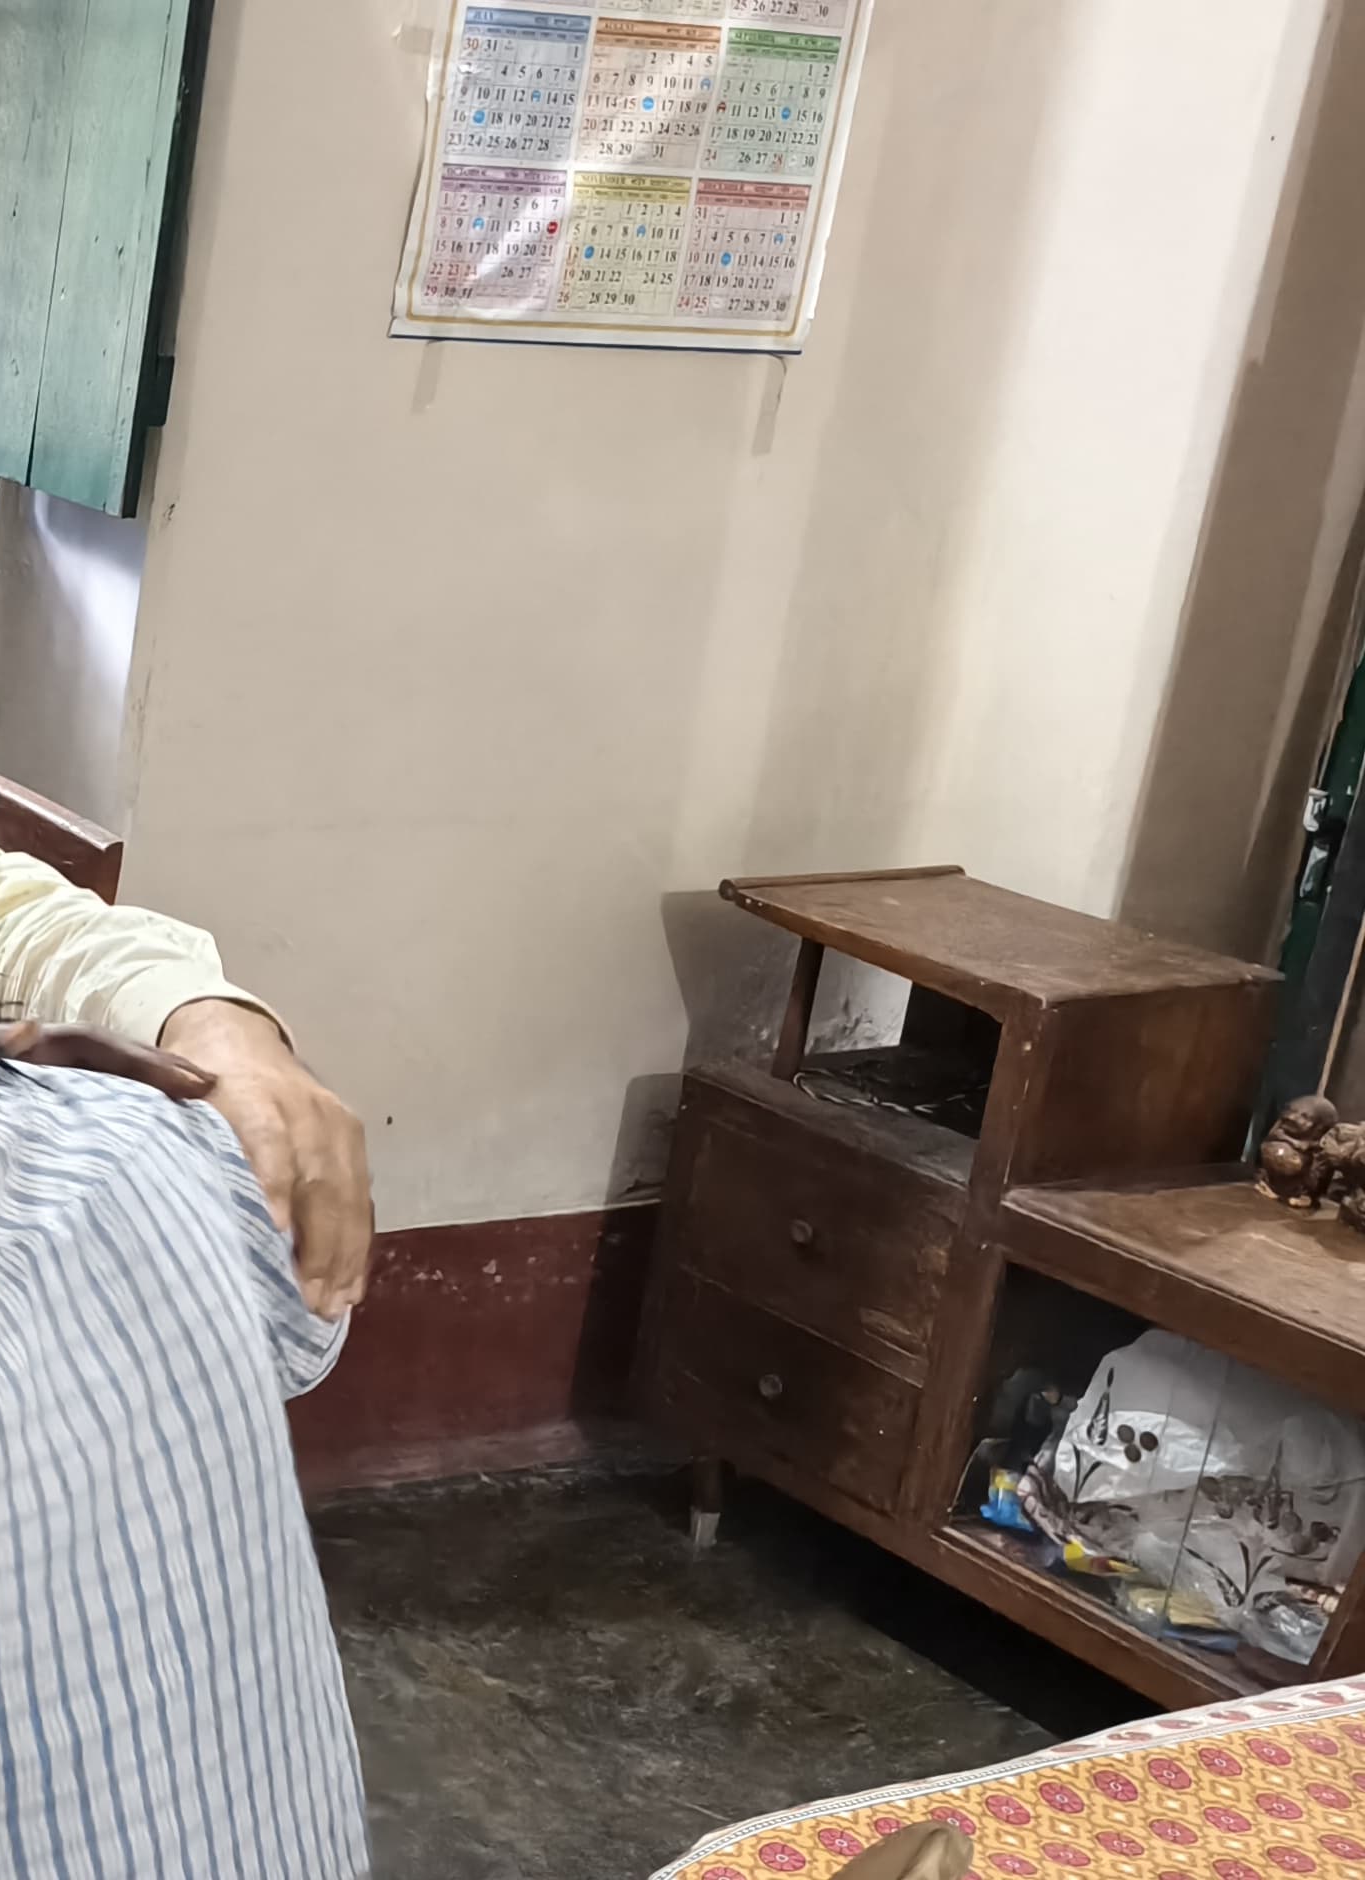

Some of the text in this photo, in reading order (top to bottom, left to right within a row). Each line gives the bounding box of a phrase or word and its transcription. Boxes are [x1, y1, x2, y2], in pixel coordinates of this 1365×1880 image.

[753, 1, 765, 12] 26
[787, 3, 798, 14] 28
[465, 38, 578, 58] 30 31 1
[651, 52, 657, 63] 2
[668, 53, 674, 64] 3
[705, 56, 712, 67] 5
[519, 67, 526, 78] 5
[537, 69, 542, 79] 6
[553, 69, 560, 79] 7
[808, 64, 829, 77] 1 2
[613, 73, 693, 89] 7 8 9 10 11
[739, 82, 745, 93] 4
[753, 83, 760, 94] 5
[771, 85, 777, 95] 6
[477, 87, 575, 106] 10 11 12 14 15
[605, 97, 617, 108] 14
[662, 100, 674, 111] 17
[680, 101, 691, 112] 18
[696, 102, 707, 113] 19
[732, 105, 741, 116] 11
[748, 106, 758, 117] 12
[765, 108, 775, 119] 13
[797, 110, 807, 121] 15
[491, 112, 570, 129] 18 19 20 21 22
[601, 120, 613, 131] 21
[621, 121, 633, 133] 22
[727, 128, 738, 139] 18
[744, 129, 755, 140] 19
[759, 130, 771, 141] 20
[775, 131, 786, 143] 21
[487, 136, 500, 148] 25
[505, 137, 517, 149] 26
[521, 138, 533, 150] 27
[538, 139, 549, 151] 28
[619, 143, 632, 155] 29
[739, 152, 814, 167] 26 27 30
[532, 199, 538, 209] 6
[552, 199, 558, 210] 7
[781, 213, 785, 223] 1
[490, 221, 500, 231] 11
[508, 221, 520, 232] 12
[528, 222, 540, 233] 13
[574, 224, 679, 239] 5 10 11
[711, 231, 717, 242] 4
[727, 232, 734, 243] 5
[744, 233, 749, 243] 6
[760, 234, 765, 244] 7
[436, 240, 446, 251] 15
[451, 241, 462, 252] 16
[469, 242, 481, 253] 17
[507, 244, 518, 255] 19
[523, 244, 536, 256] 20
[616, 248, 627, 259] 15
[648, 250, 659, 261] 17
[666, 251, 676, 262] 18
[705, 253, 714, 264] 11
[738, 255, 747, 265] 13
[753, 256, 764, 267] 14
[769, 257, 779, 267] 15
[784, 257, 795, 268] 16
[519, 267, 531, 278] 27
[579, 270, 673, 284] 20 21 22 24 25
[699, 276, 711, 286] 18
[717, 277, 728, 287] 19
[604, 294, 617, 304] 29
[621, 294, 635, 305] 30
[695, 298, 707, 308] 25
[728, 299, 739, 310] 27
